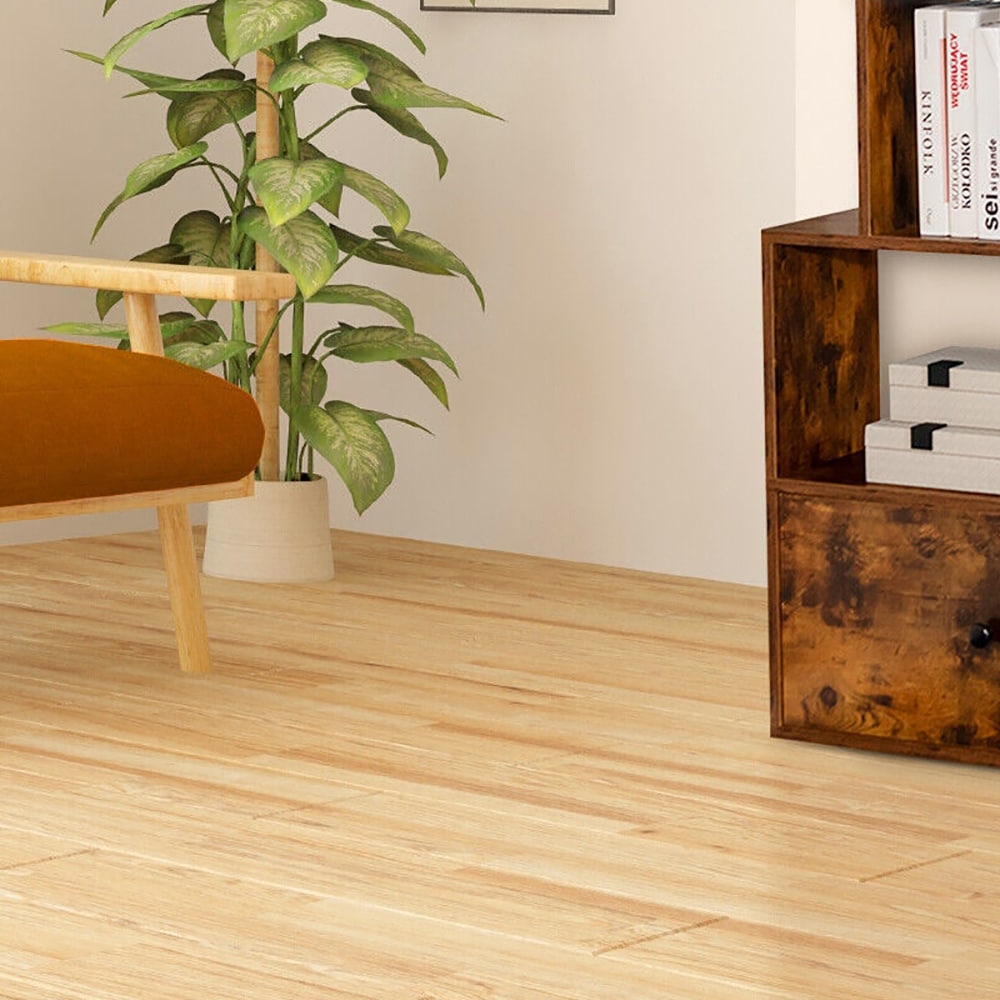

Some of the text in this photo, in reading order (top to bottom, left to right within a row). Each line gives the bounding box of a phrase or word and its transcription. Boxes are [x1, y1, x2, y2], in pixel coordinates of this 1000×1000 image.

[960, 52, 970, 91] ŚWIAT
[921, 91, 934, 175] KINFOLK
[961, 133, 972, 210] KOŁODKO
[988, 138, 1000, 179] grande
[981, 194, 999, 231] sei
